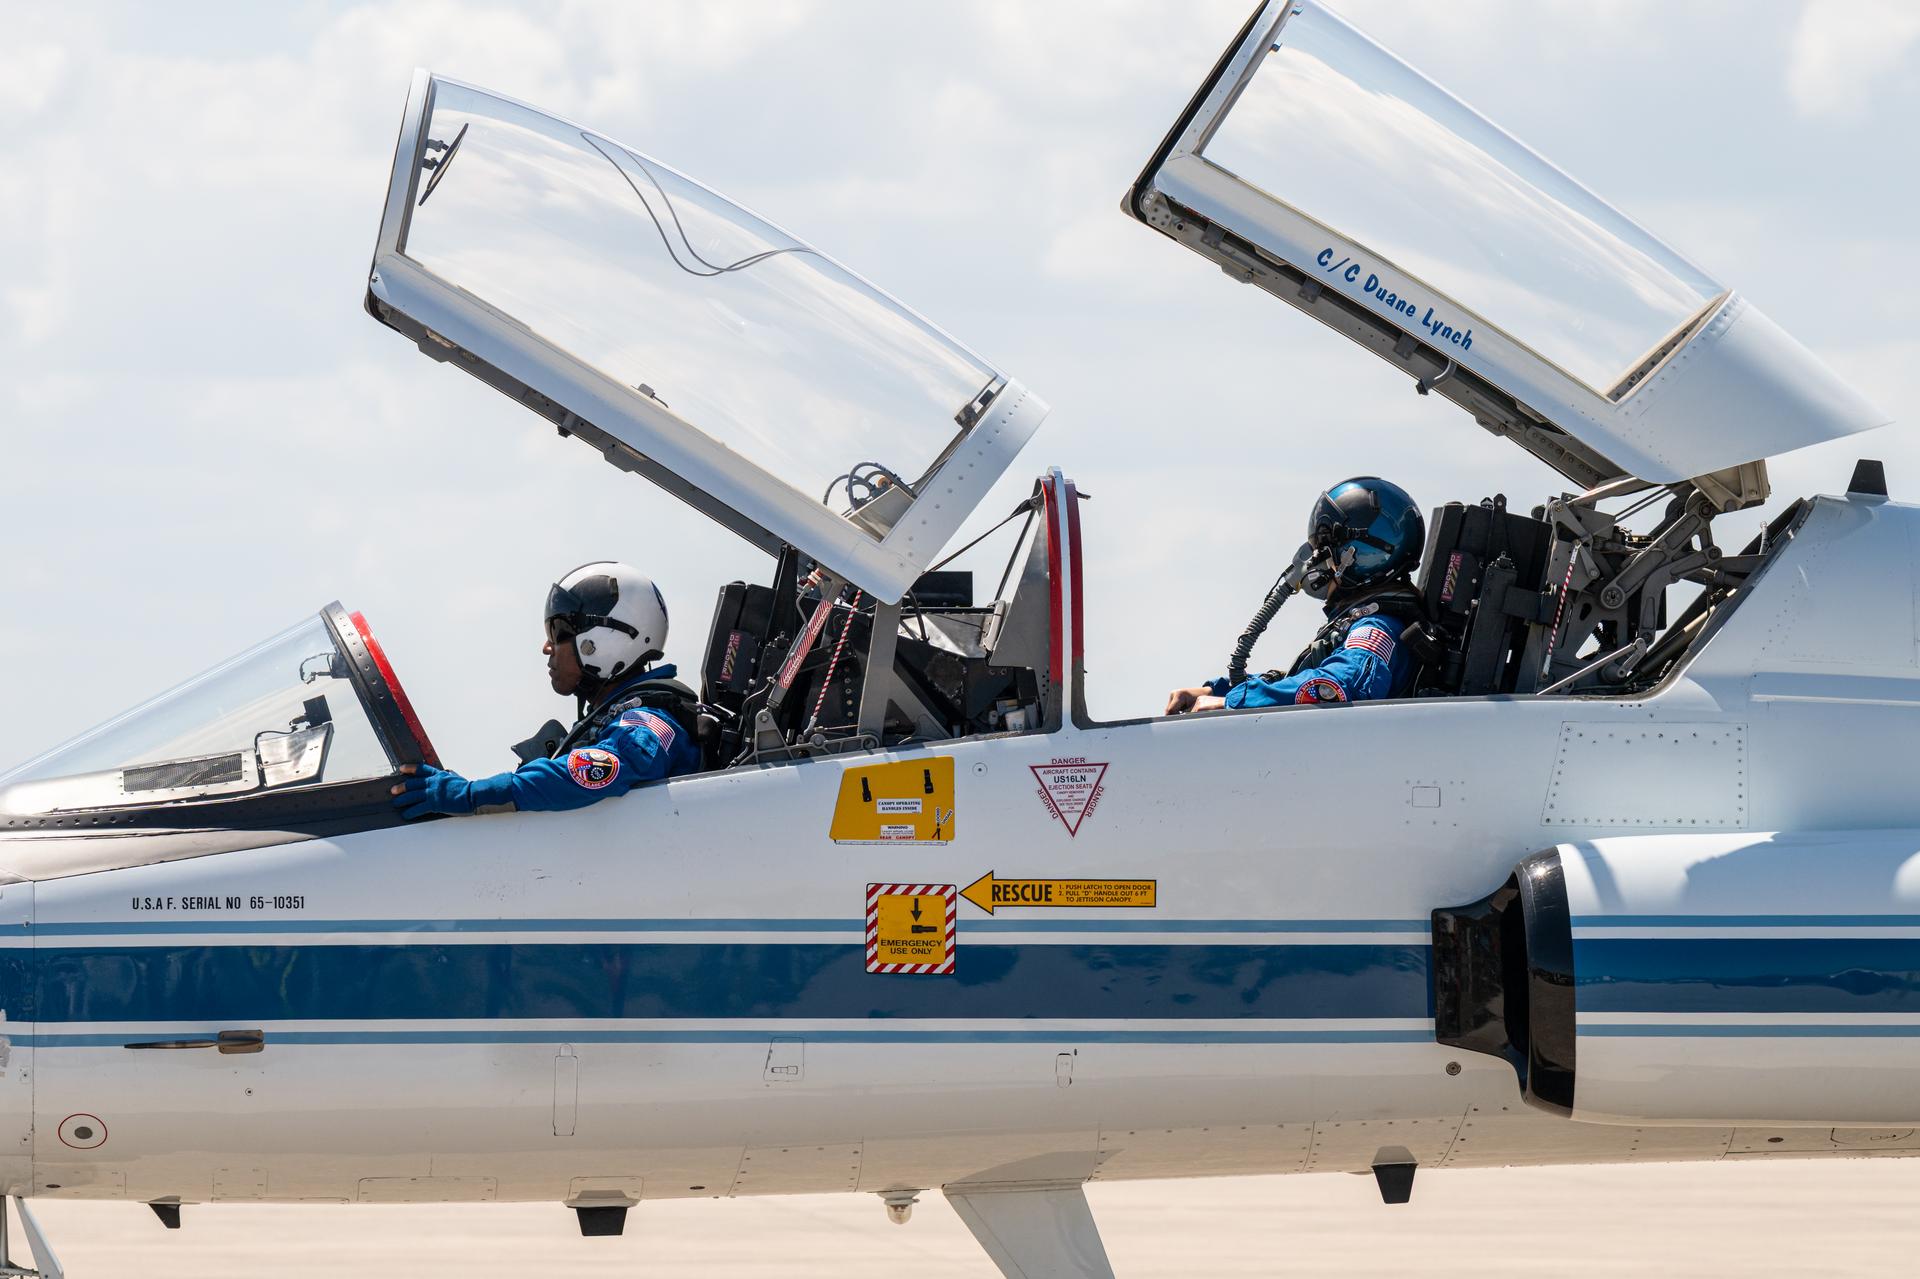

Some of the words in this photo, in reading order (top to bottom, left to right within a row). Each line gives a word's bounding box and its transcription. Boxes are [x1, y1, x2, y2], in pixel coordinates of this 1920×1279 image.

[1317, 248, 1360, 282] C/C
[1363, 273, 1416, 317] Duane
[1422, 307, 1473, 351] Lynch
[1442, 554, 1456, 594] DANGER
[721, 634, 735, 674] DANGER
[1053, 775, 1086, 783] US16LN
[1037, 788, 1059, 819] DANGER
[1085, 785, 1105, 818] DANGER
[181, 896, 222, 910] SERIAL
[225, 896, 241, 909] NO
[250, 896, 305, 909] 65-10351
[991, 884, 1052, 902] RESCUE
[880, 939, 942, 947] EMERGENCY
